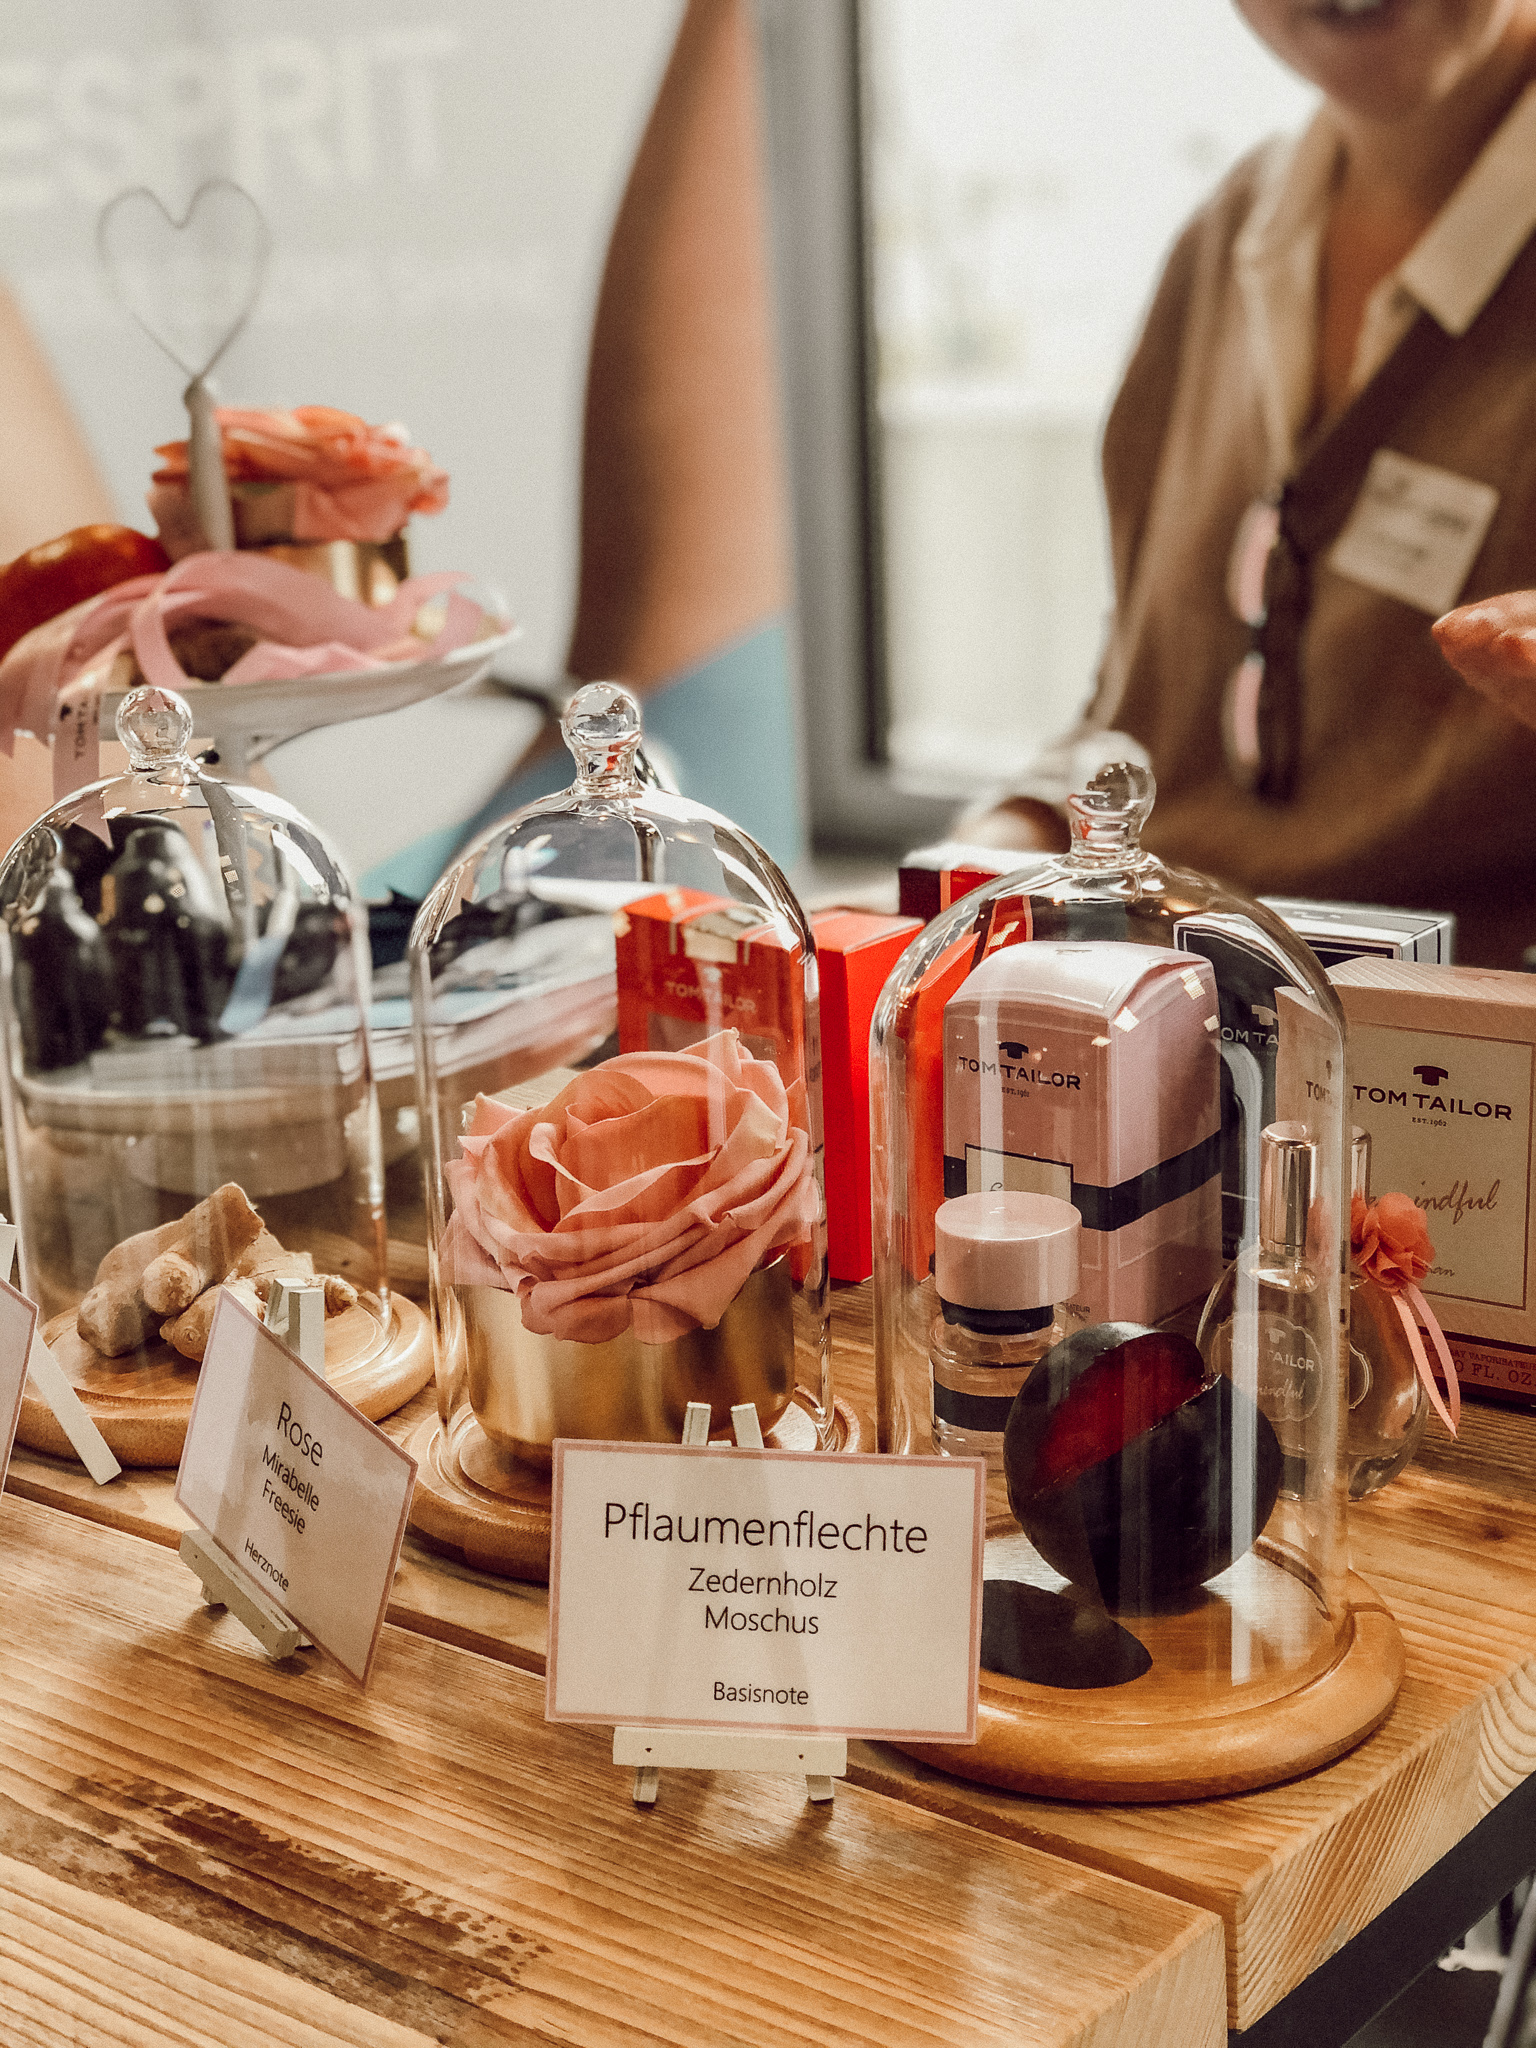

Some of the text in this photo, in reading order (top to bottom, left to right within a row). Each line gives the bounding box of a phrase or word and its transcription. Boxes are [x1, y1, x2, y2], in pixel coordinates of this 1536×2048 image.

[1220, 1026, 1278, 1046] OM TA
[958, 1056, 1081, 1091] TOM TAILOR
[1352, 1085, 1407, 1107] TOM
[1412, 1093, 1512, 1121] TAILOR
[1411, 1116, 1447, 1128] EST.1962
[1413, 1178, 1501, 1225] indful
[1471, 1362, 1501, 1381] FL.
[276, 1401, 324, 1467] Rose
[262, 1444, 320, 1512] Mirabelle
[262, 1478, 306, 1534] Freesie
[604, 1501, 928, 1554] Pflaumenflechte
[244, 1537, 289, 1592] Herznote
[688, 1567, 838, 1598] Zedernholz
[705, 1604, 819, 1635] Moschus
[713, 1681, 809, 1706] Basisnote
